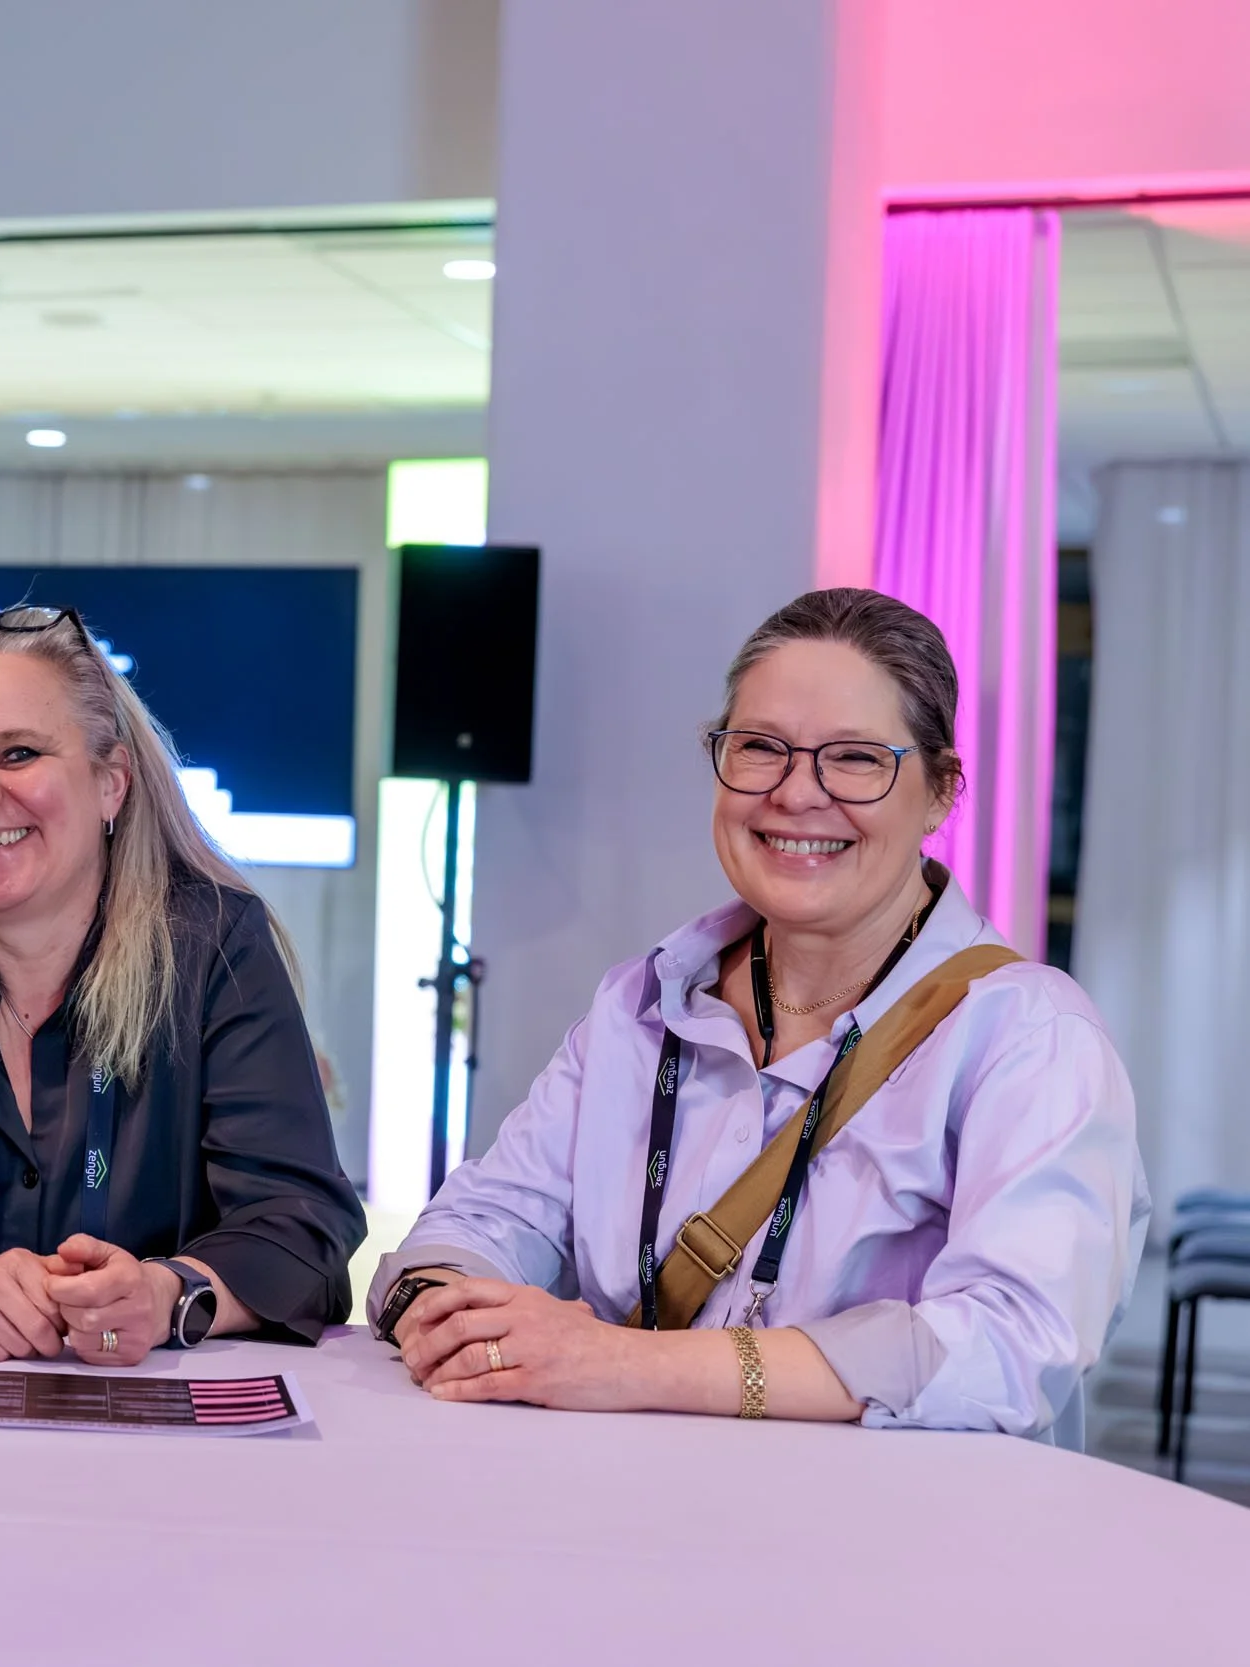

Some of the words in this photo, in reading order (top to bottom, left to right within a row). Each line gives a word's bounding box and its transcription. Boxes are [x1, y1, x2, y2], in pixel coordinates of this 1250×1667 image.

[91, 1061, 103, 1093] engun
[666, 1057, 677, 1095] zengun
[85, 1150, 97, 1188] zengun
[655, 1150, 667, 1187] zengun
[769, 1197, 788, 1237] zengun
[645, 1243, 654, 1283] zengun
